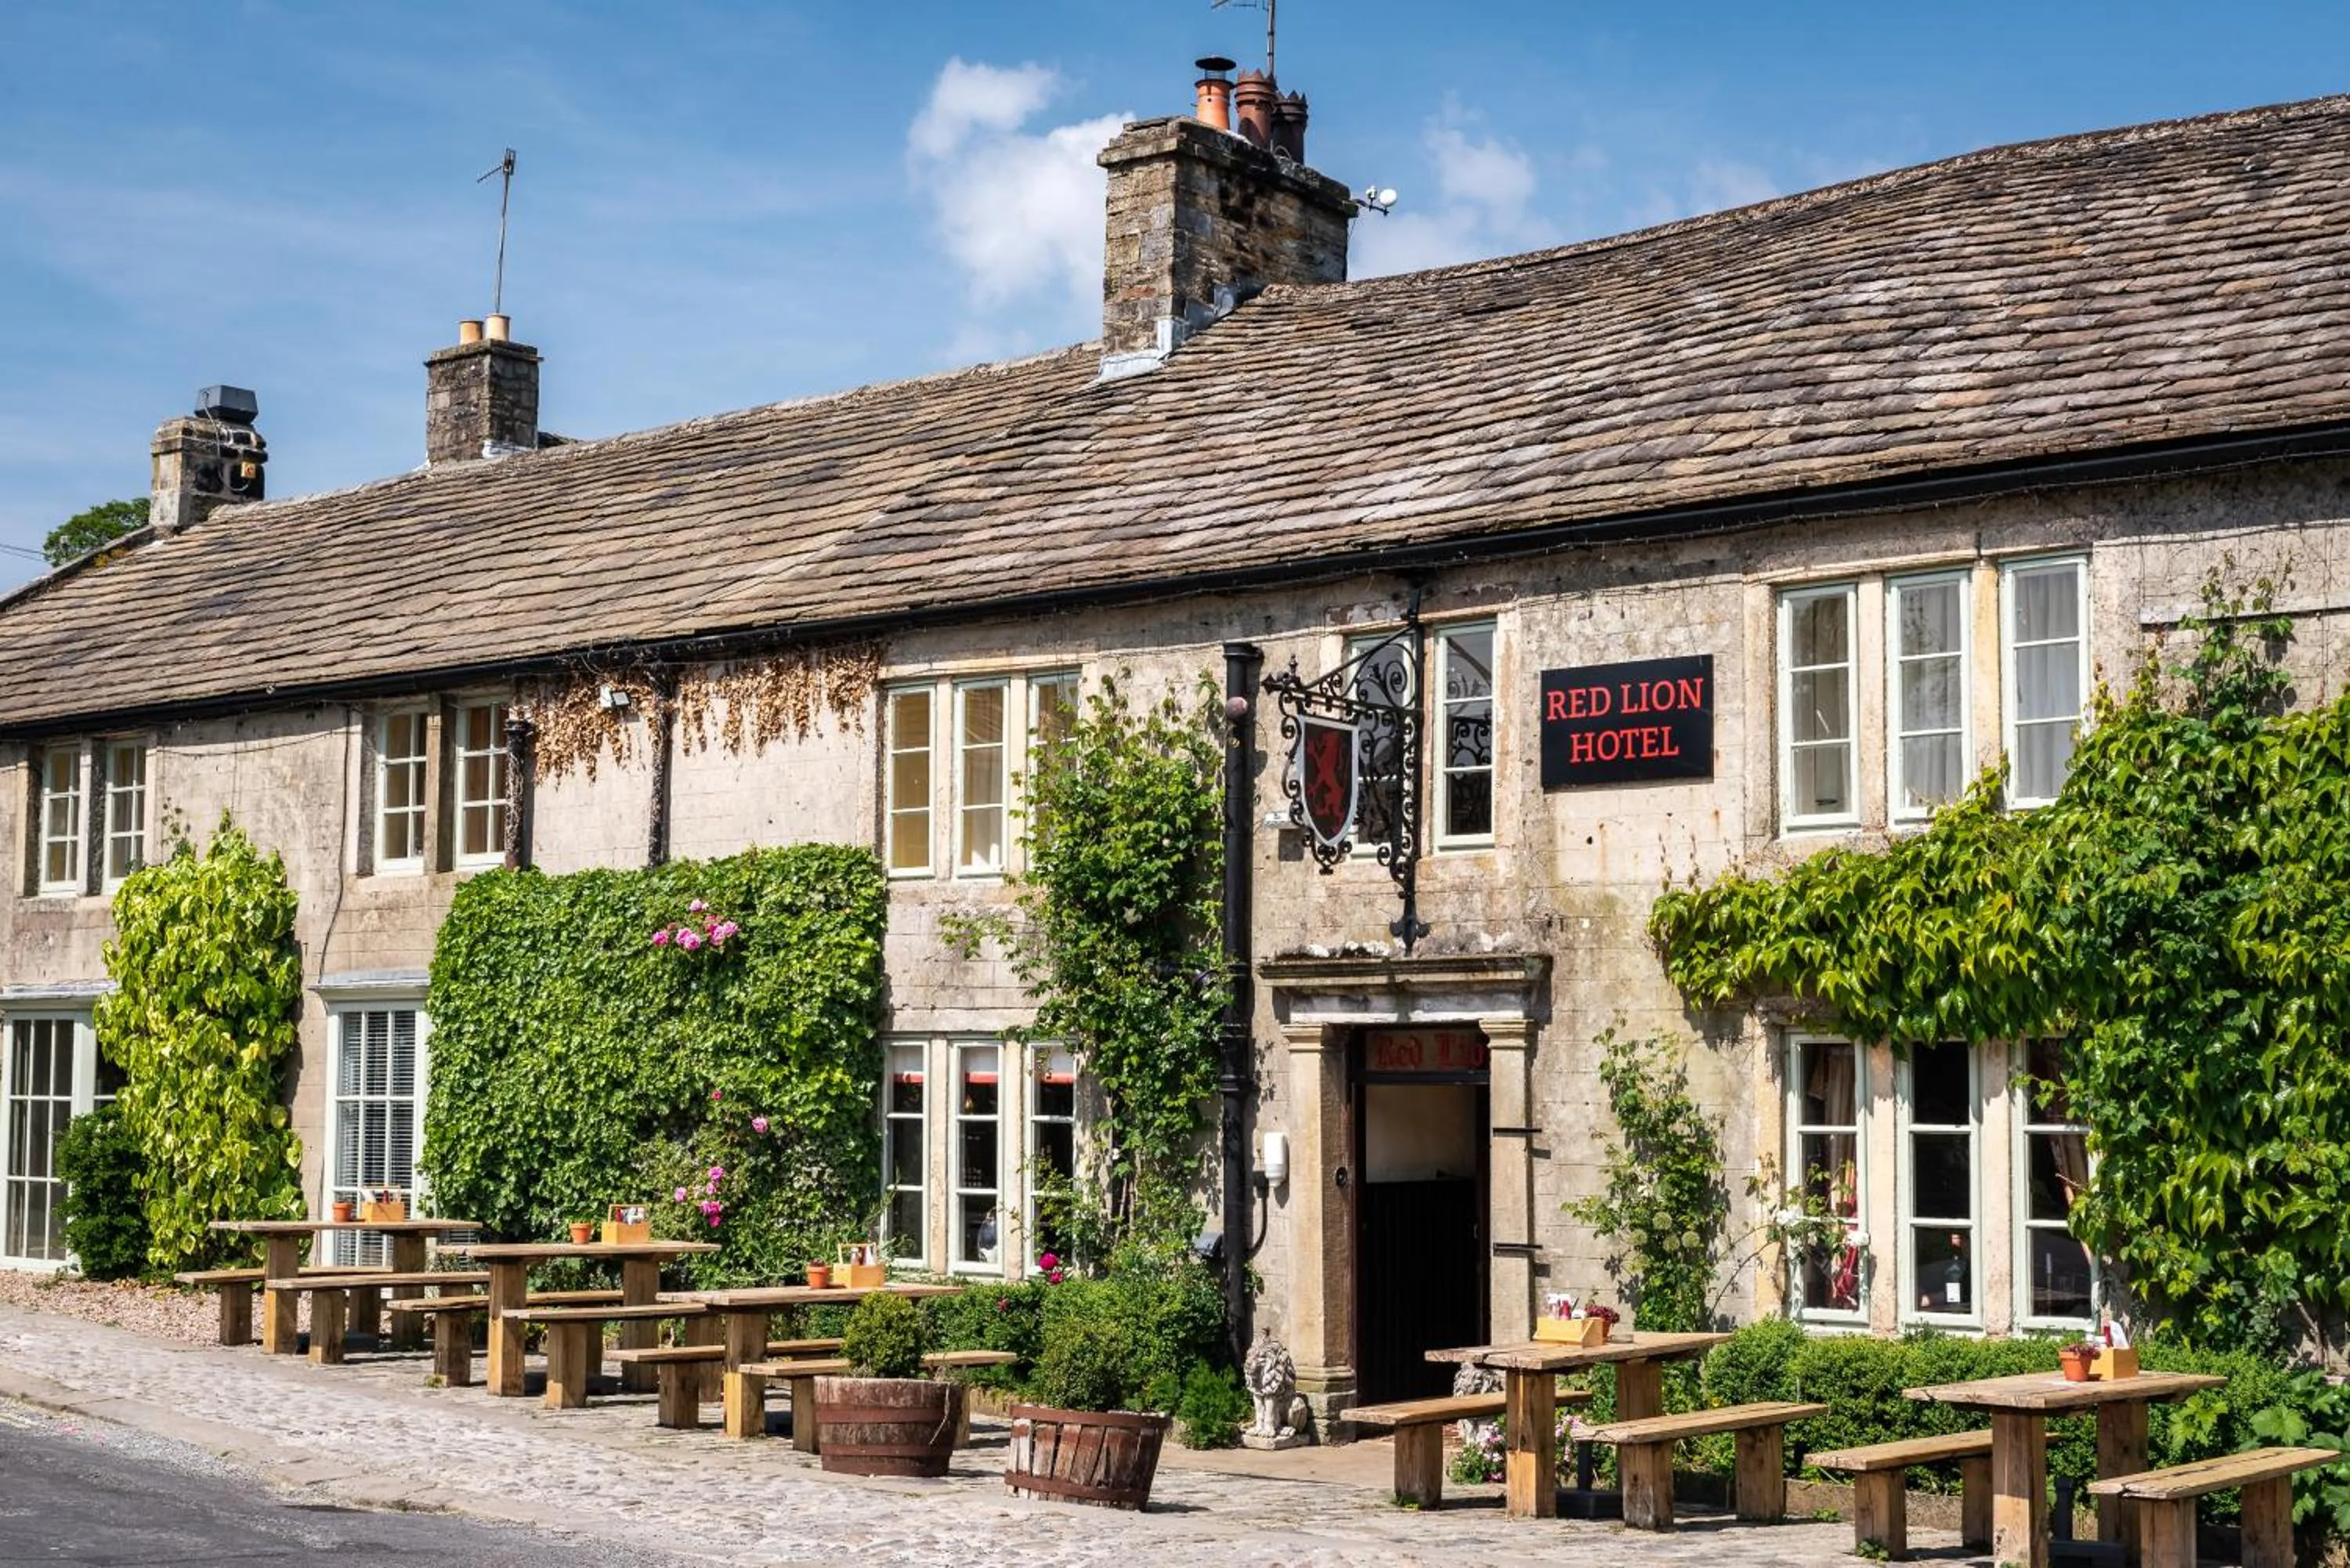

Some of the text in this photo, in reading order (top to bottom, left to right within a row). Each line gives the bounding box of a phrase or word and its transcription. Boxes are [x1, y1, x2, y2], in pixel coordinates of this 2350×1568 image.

[1546, 677, 1704, 721] RED LION
[1569, 726, 1679, 764] HOTEL
[1376, 1035, 1423, 1069] Red
